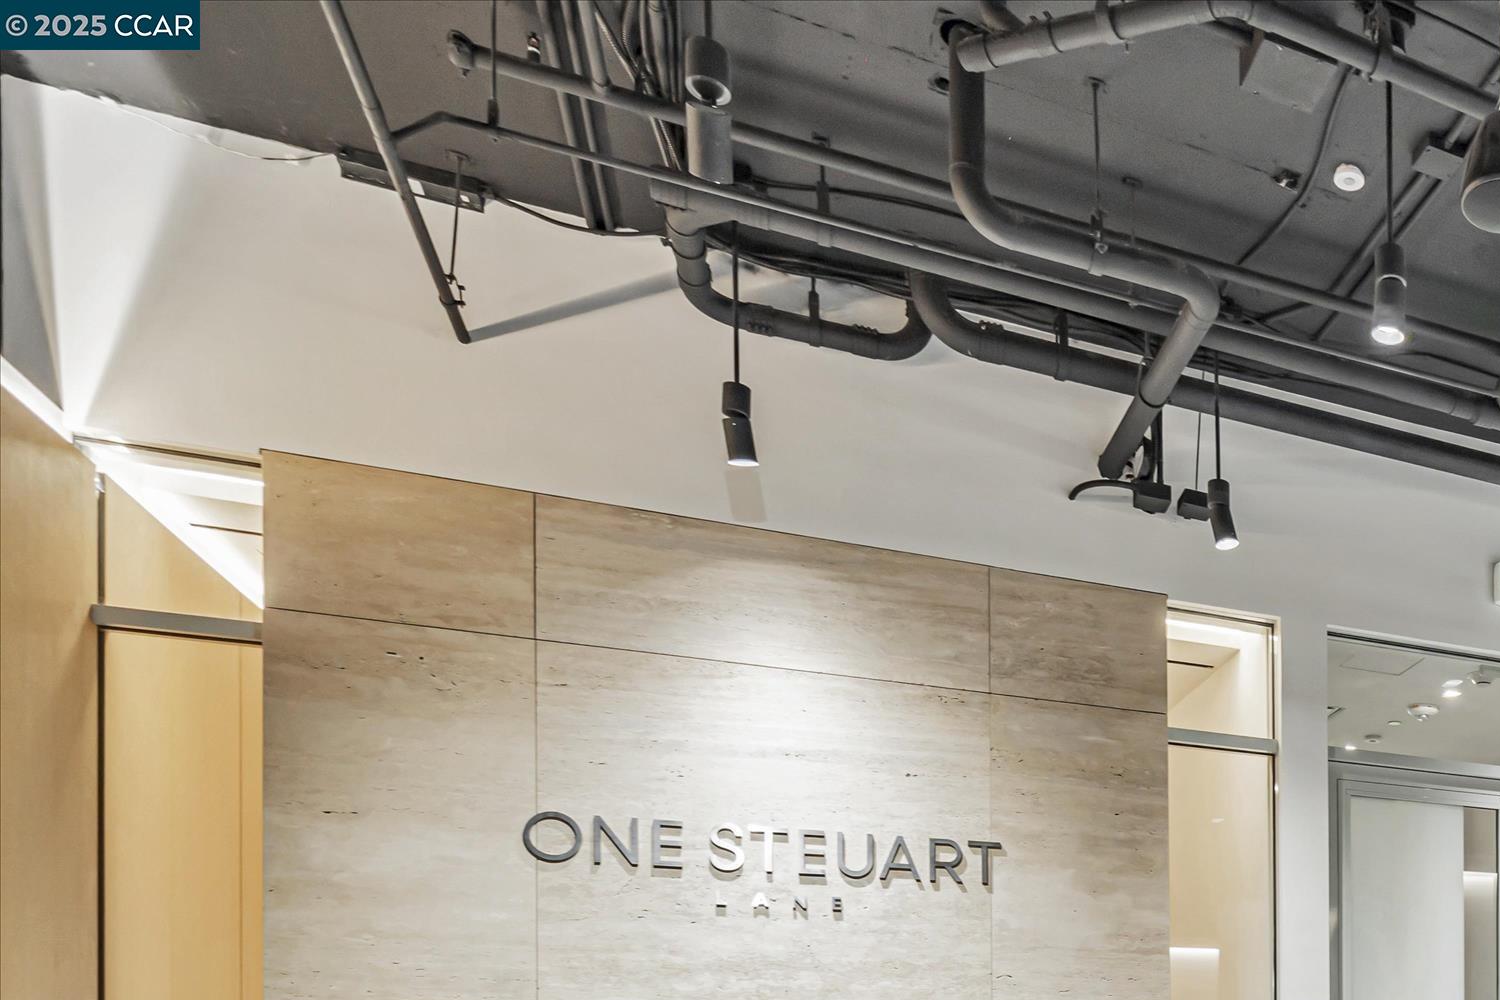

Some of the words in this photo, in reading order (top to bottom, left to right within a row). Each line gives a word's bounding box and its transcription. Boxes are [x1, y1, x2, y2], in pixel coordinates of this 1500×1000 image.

[522, 811, 684, 868] ONE
[709, 822, 1003, 886] STEUART
[716, 892, 842, 913] LANE
